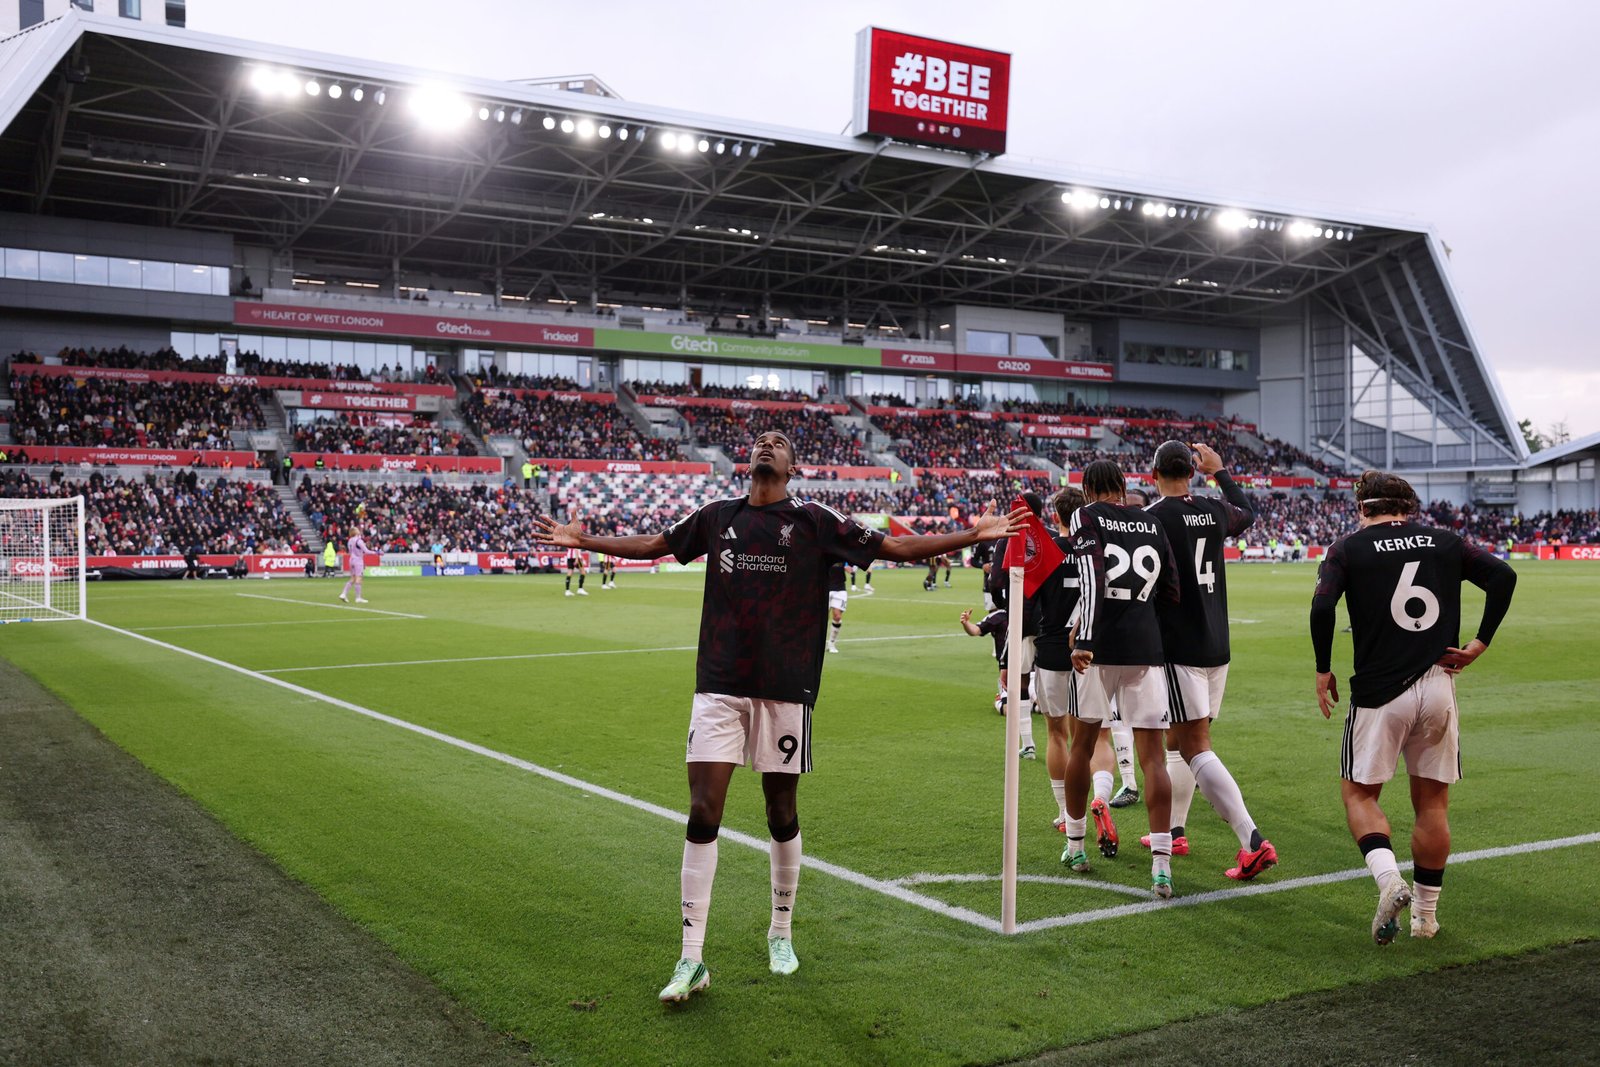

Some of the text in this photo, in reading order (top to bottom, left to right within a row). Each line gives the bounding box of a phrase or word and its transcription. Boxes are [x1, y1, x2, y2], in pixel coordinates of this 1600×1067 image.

[891, 52, 991, 100] #BEE
[891, 88, 988, 121] TOGETHER
[263, 310, 384, 327] HEART OF WEST LONDON
[671, 335, 810, 357] Gtech Community Stadium
[997, 360, 1031, 371] CAZOO
[344, 395, 409, 408] TOGETHER
[1047, 425, 1087, 437] TOGETHER
[1183, 513, 1216, 527] VIRGIL
[1373, 535, 1436, 552] KERKEZ
[737, 552, 785, 564] standard
[1195, 538, 1215, 593] 4
[736, 561, 787, 573] chartered
[1104, 543, 1161, 602] 29
[1390, 561, 1440, 631] 6
[777, 735, 798, 764] 9
[774, 888, 792, 897] LFC
